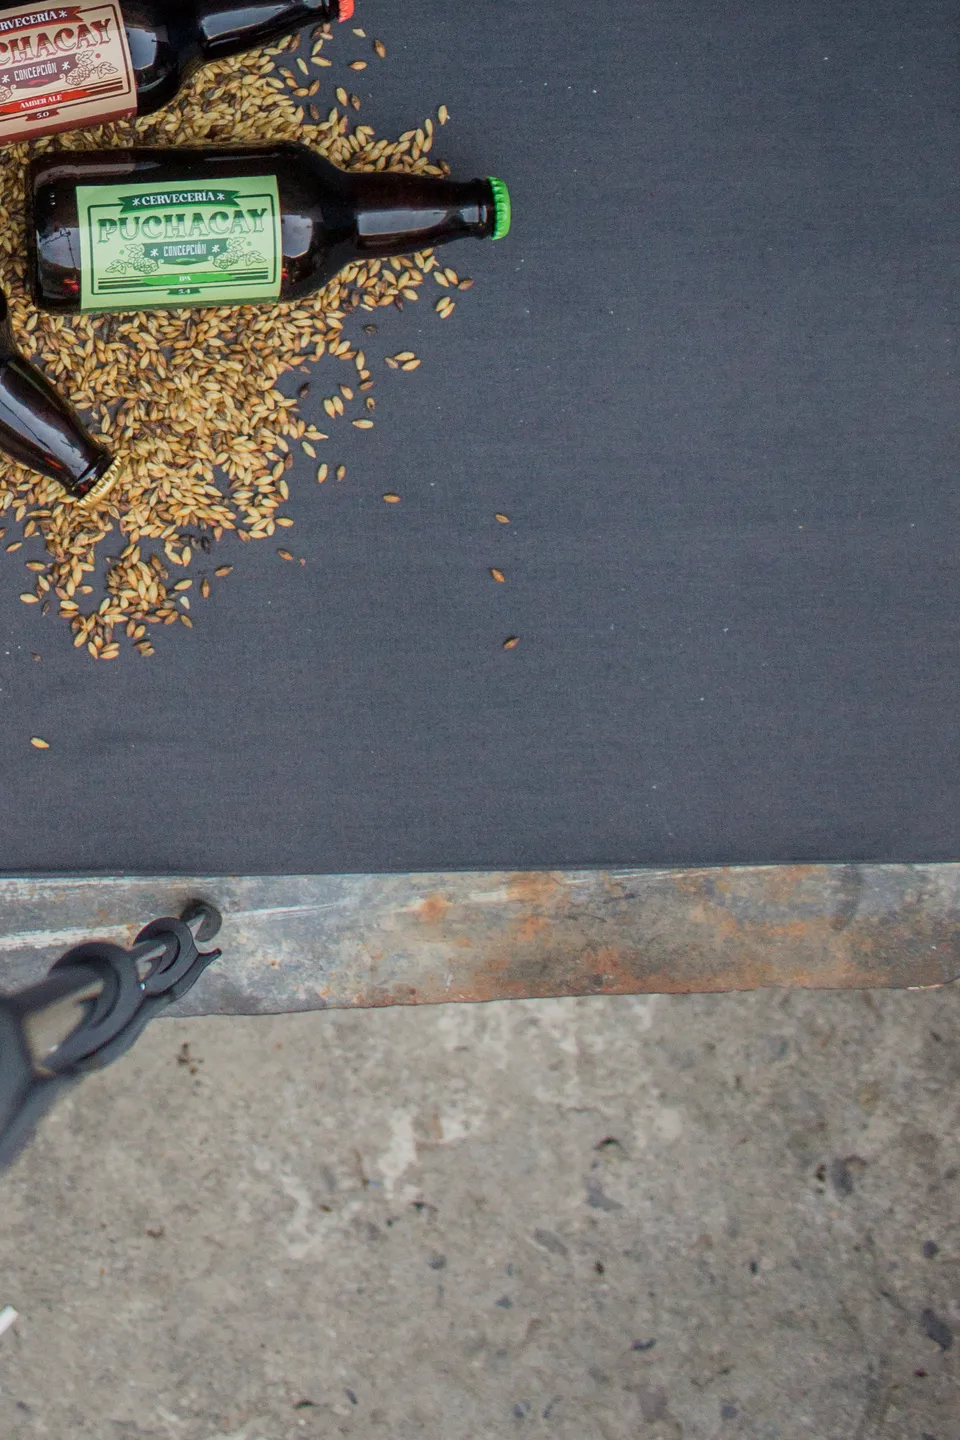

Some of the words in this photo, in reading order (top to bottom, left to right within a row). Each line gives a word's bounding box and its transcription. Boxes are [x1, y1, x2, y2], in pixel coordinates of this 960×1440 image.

[13, 61, 58, 82] CONCEPCIÓN
[20, 97, 47, 109] AMBER
[47, 94, 63, 104] ALE
[141, 190, 215, 206] CERVECERÍA
[96, 208, 269, 244] PUCHACAY
[163, 242, 208, 258] CONCEPCIÓN
